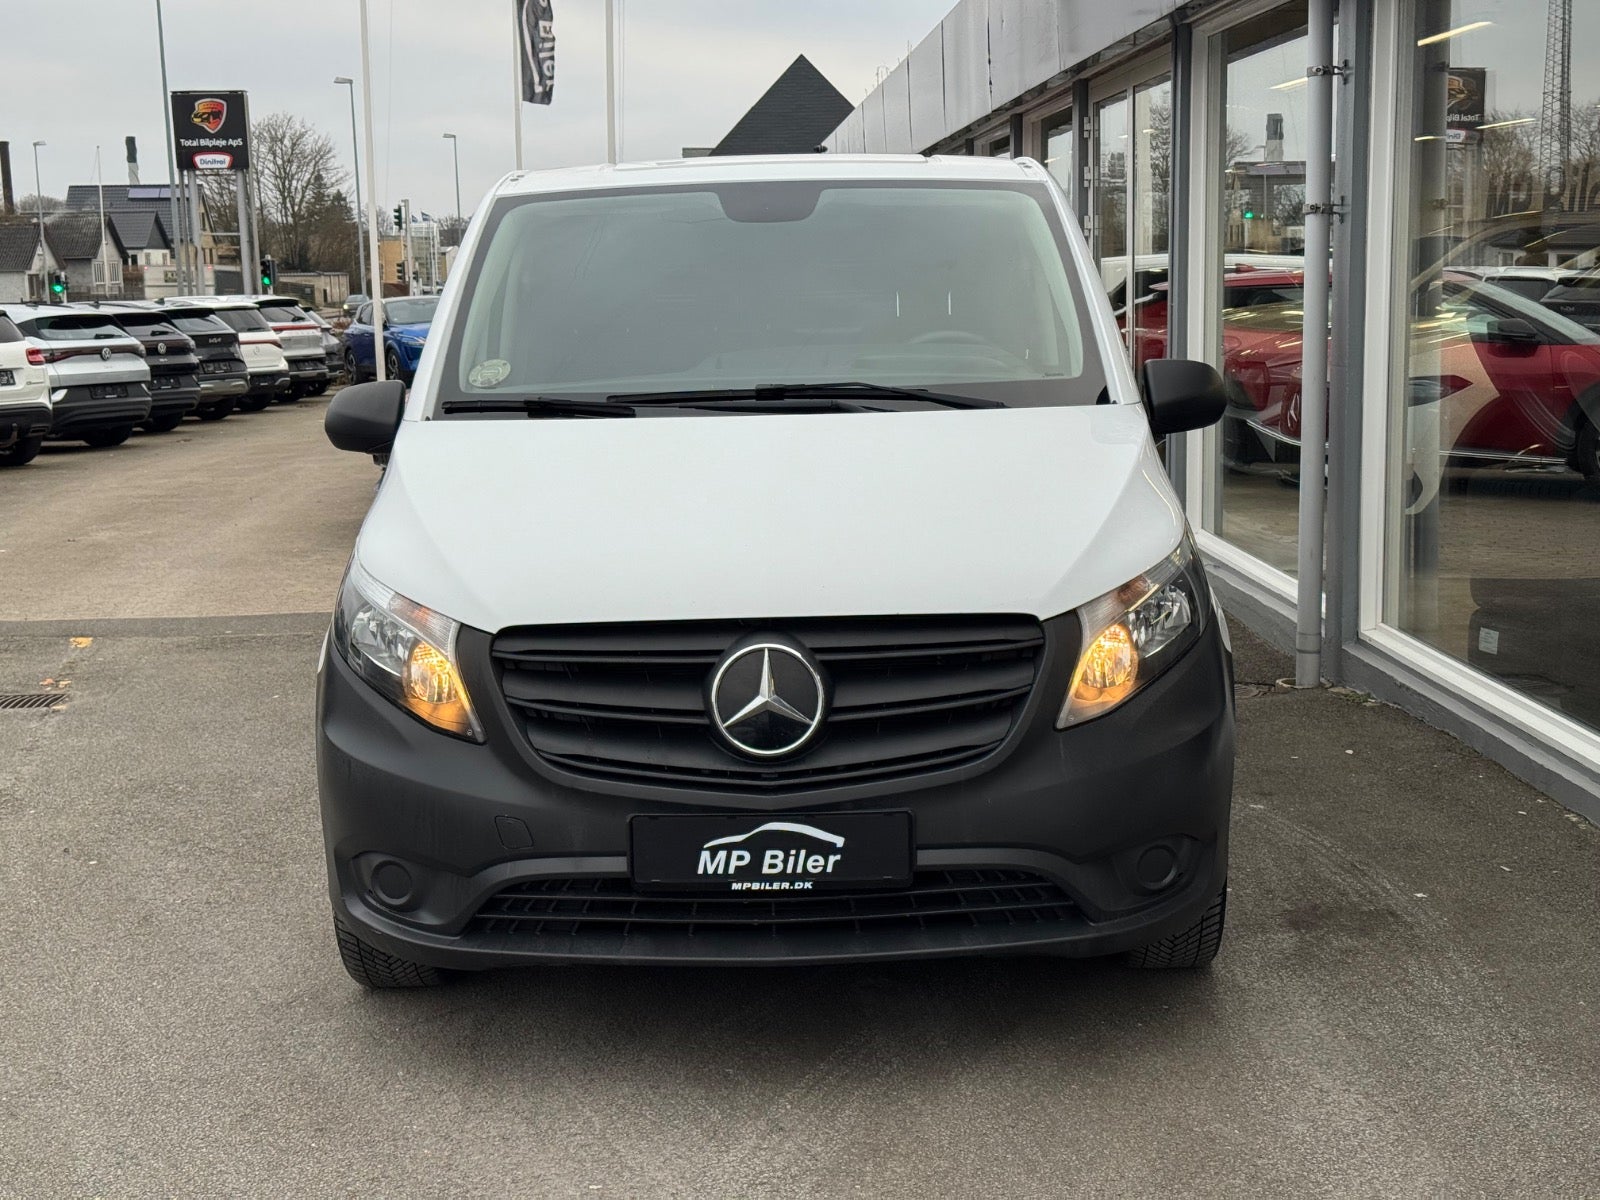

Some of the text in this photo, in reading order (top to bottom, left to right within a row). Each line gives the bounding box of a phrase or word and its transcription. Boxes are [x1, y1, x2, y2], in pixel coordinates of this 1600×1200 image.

[180, 138, 243, 148] Total Bilpleje ApS
[199, 158, 226, 166] Dinitrol
[697, 849, 842, 875] MP Biler
[731, 881, 814, 891] MPBILER.DK
